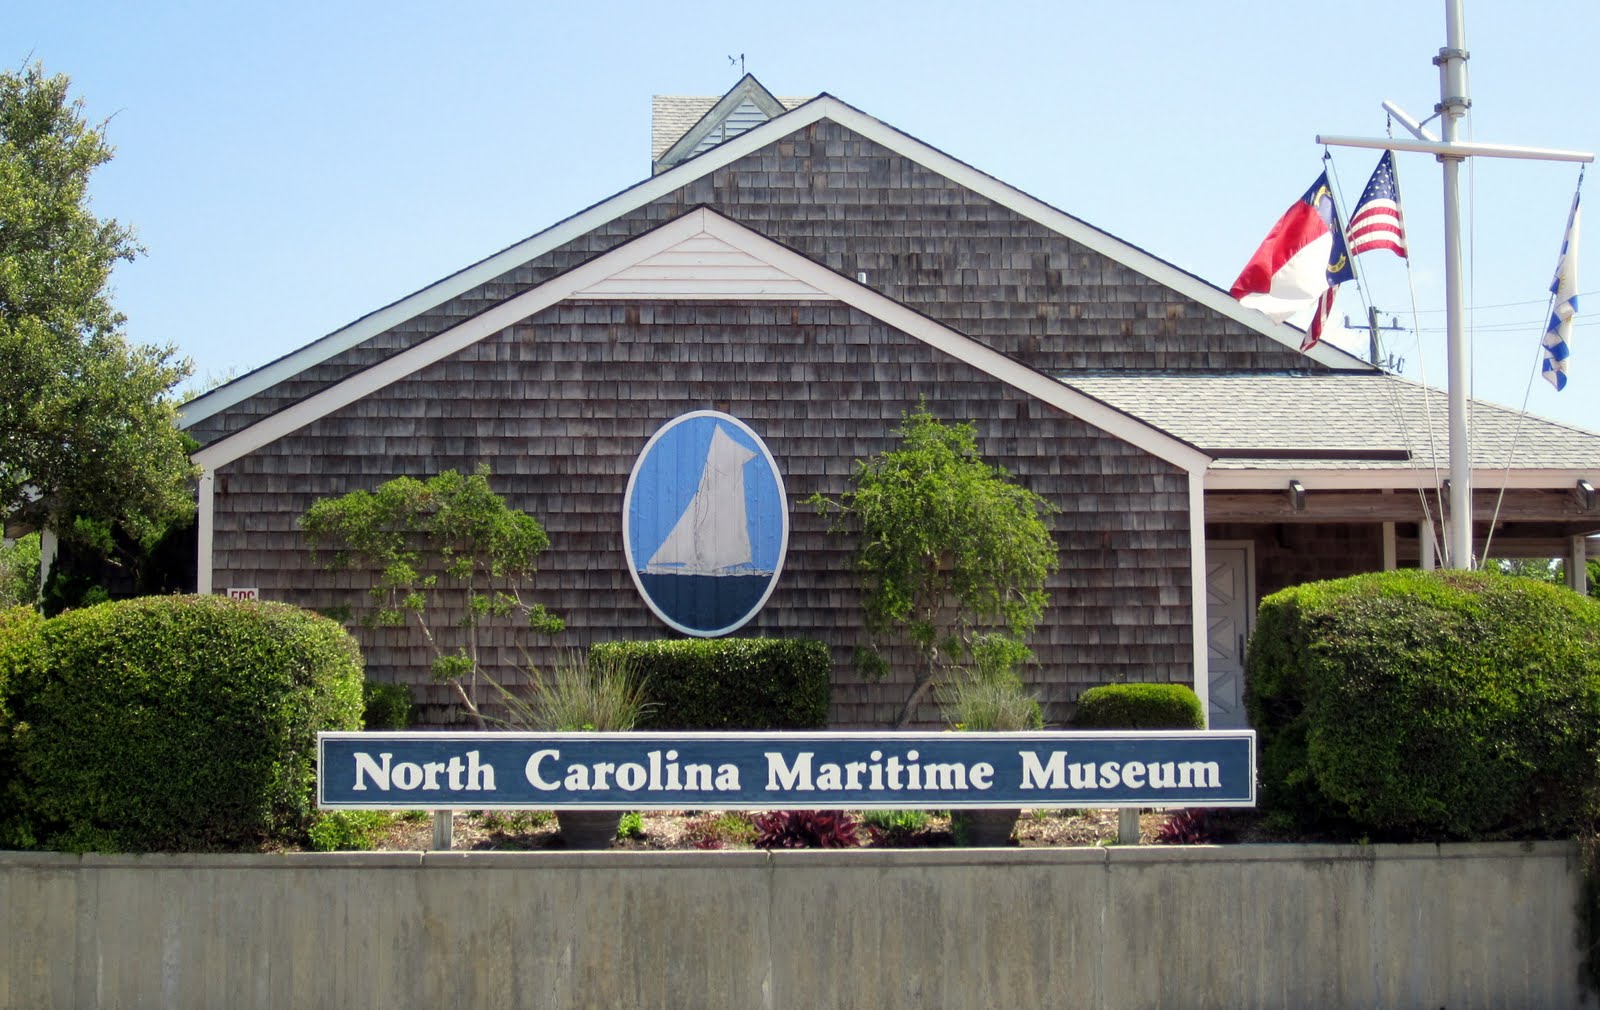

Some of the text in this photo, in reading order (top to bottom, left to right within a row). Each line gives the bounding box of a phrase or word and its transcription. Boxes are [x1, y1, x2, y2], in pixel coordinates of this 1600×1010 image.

[352, 749, 1222, 792] North Carolina Maritime Museum
